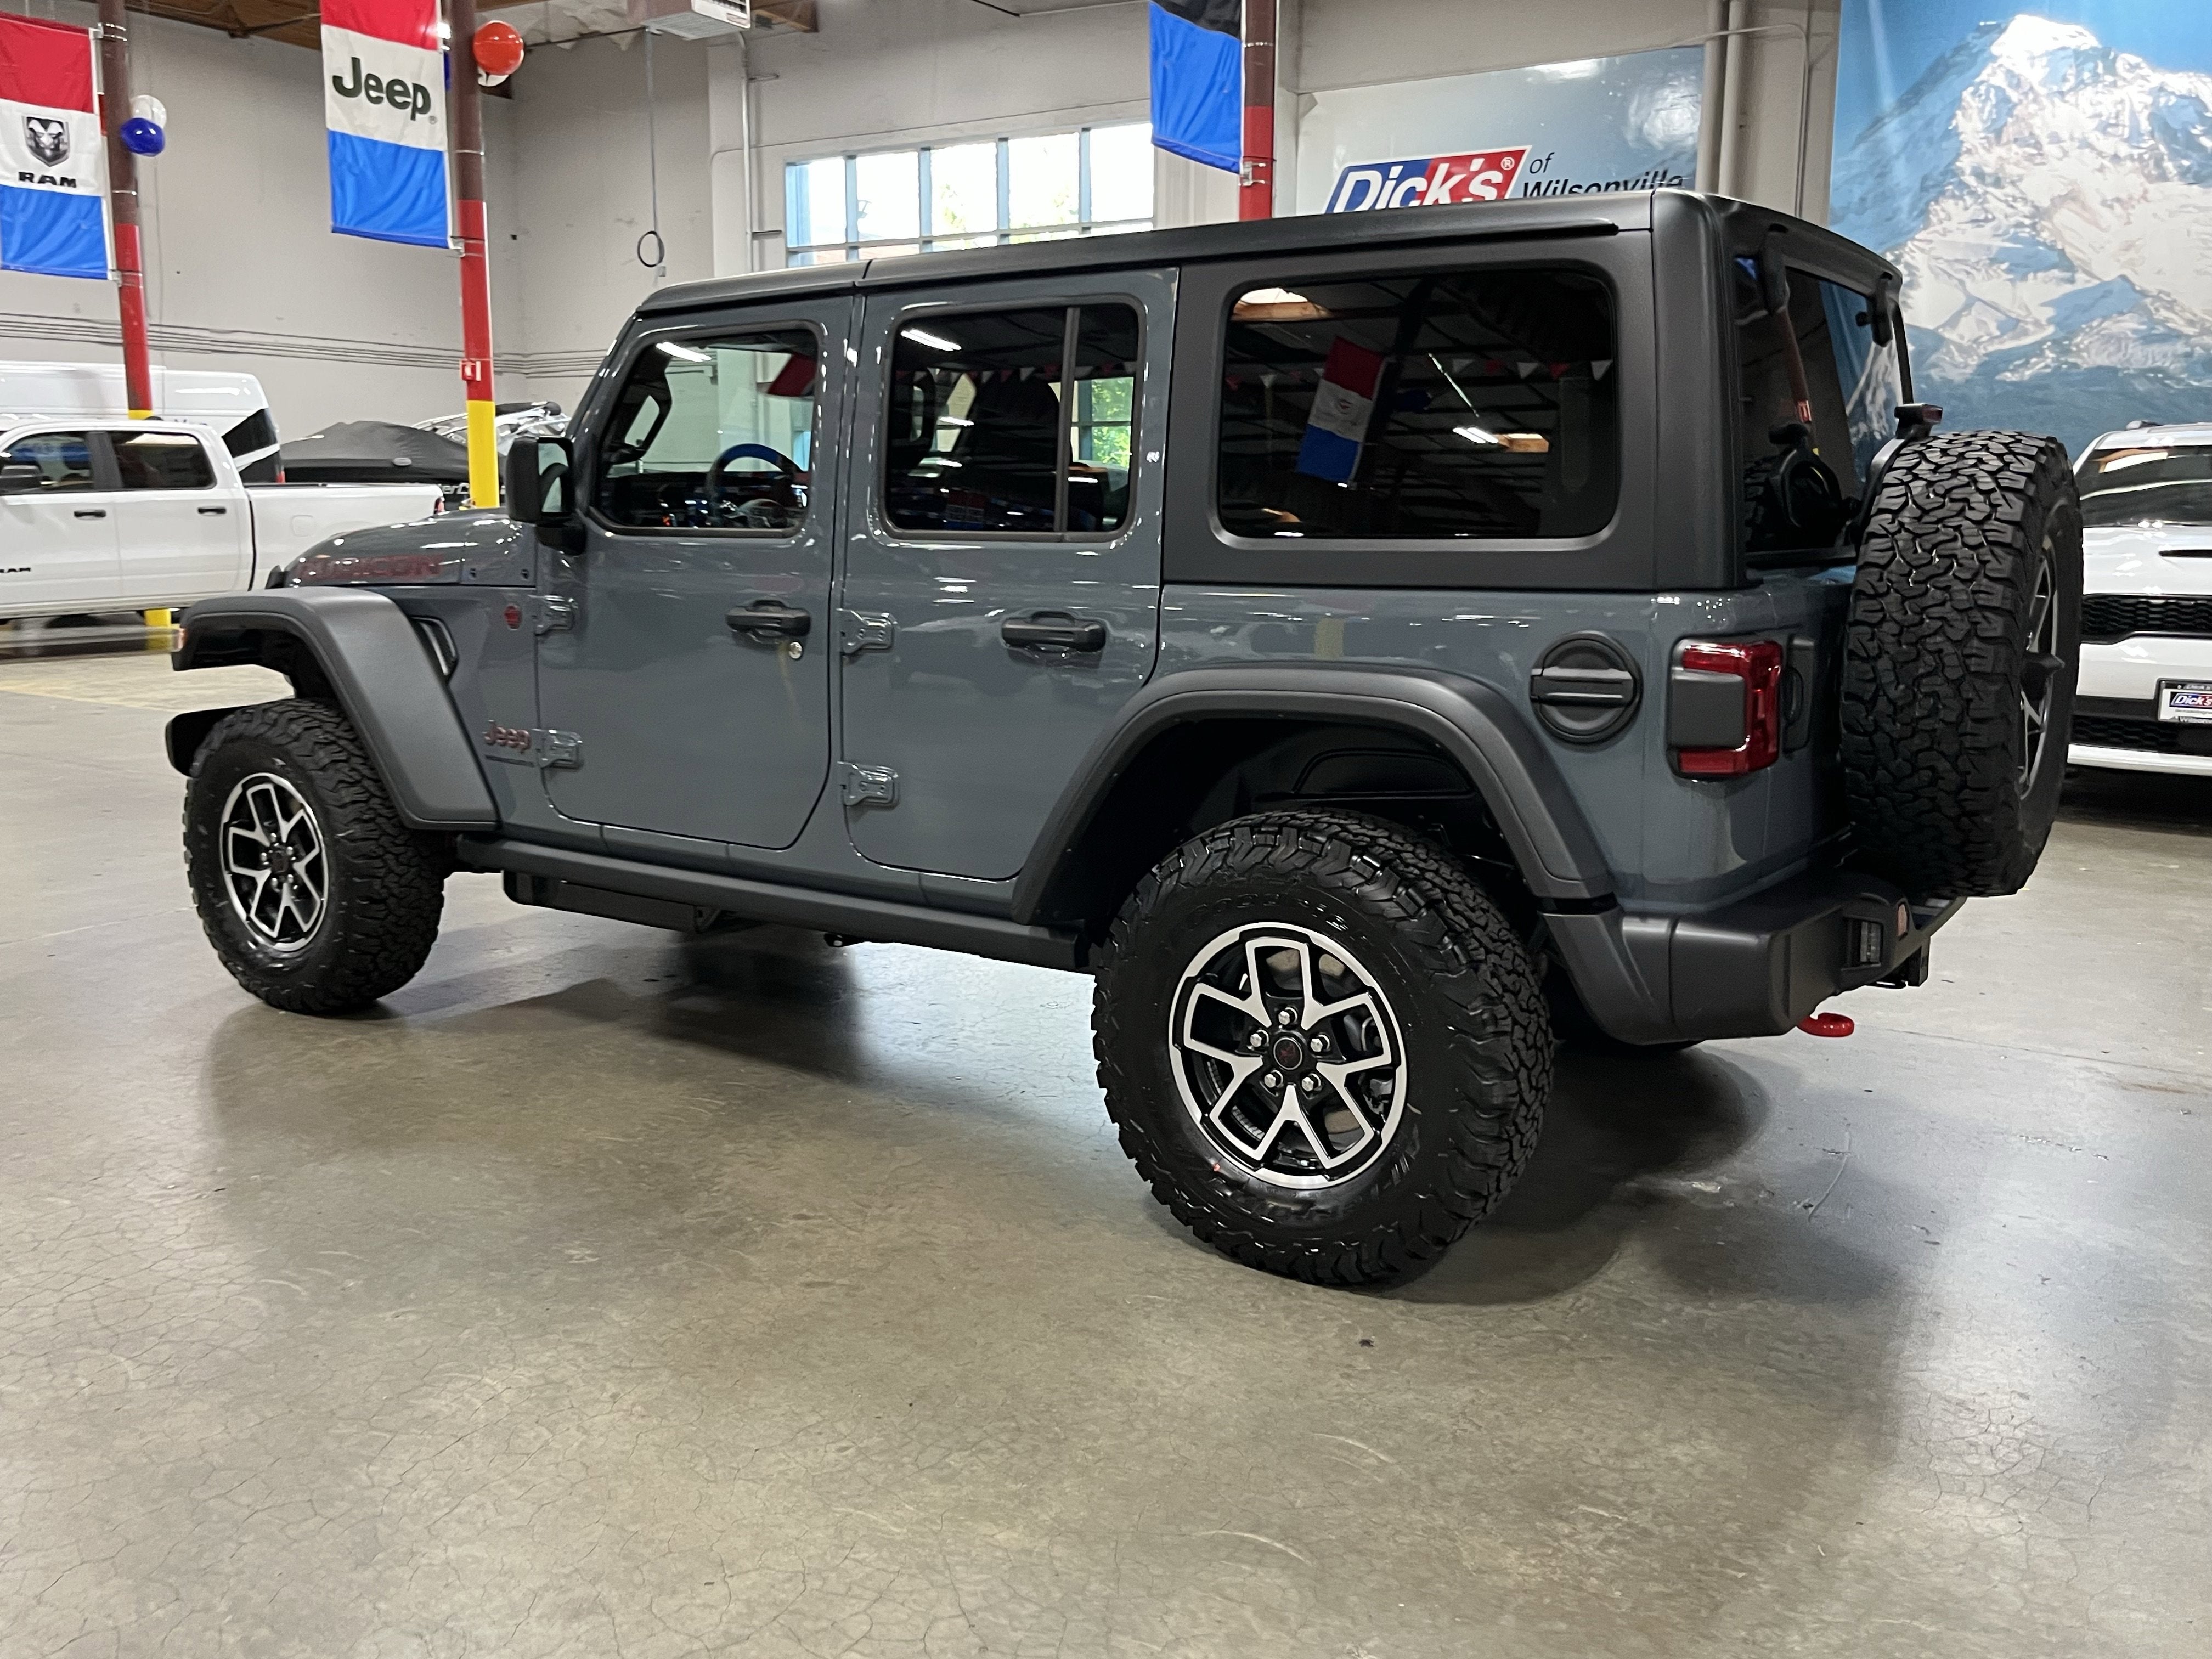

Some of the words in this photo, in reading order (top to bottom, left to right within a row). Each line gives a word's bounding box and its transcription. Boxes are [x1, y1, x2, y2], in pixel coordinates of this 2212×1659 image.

[332, 57, 431, 121] Jeep
[18, 172, 77, 188] RAM
[1333, 158, 1503, 213] Dick's
[1530, 152, 1555, 174] of
[482, 720, 532, 754] Jeep
